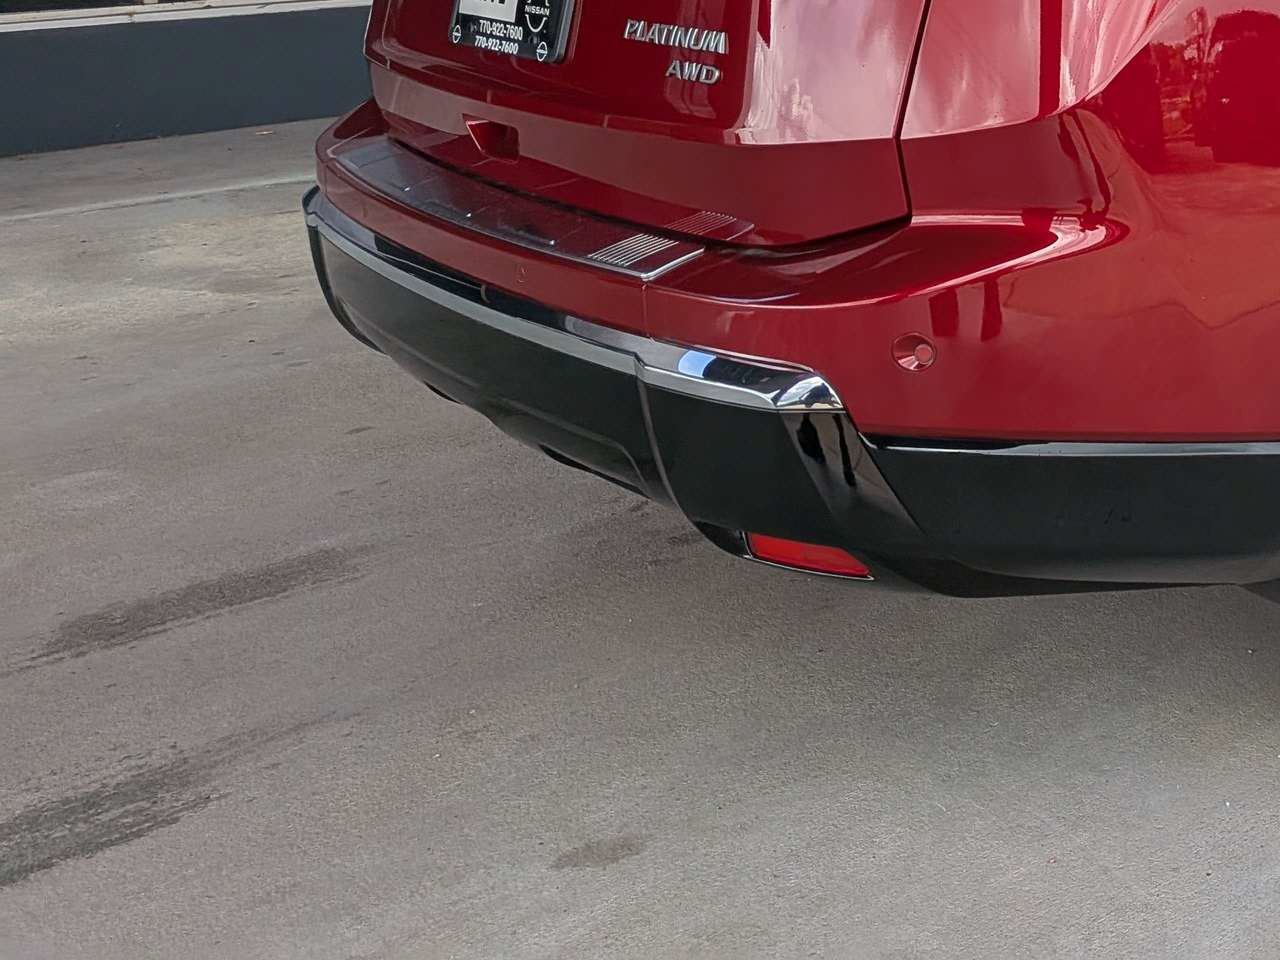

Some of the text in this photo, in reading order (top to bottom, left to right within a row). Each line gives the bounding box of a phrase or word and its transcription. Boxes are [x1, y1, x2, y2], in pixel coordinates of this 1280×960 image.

[525, 5, 550, 16] NISSAN
[479, 19, 523, 41] 770-922-7600
[624, 19, 727, 55] PLATINUM
[474, 35, 519, 55] 770-922-7600
[665, 59, 721, 84] AWD
